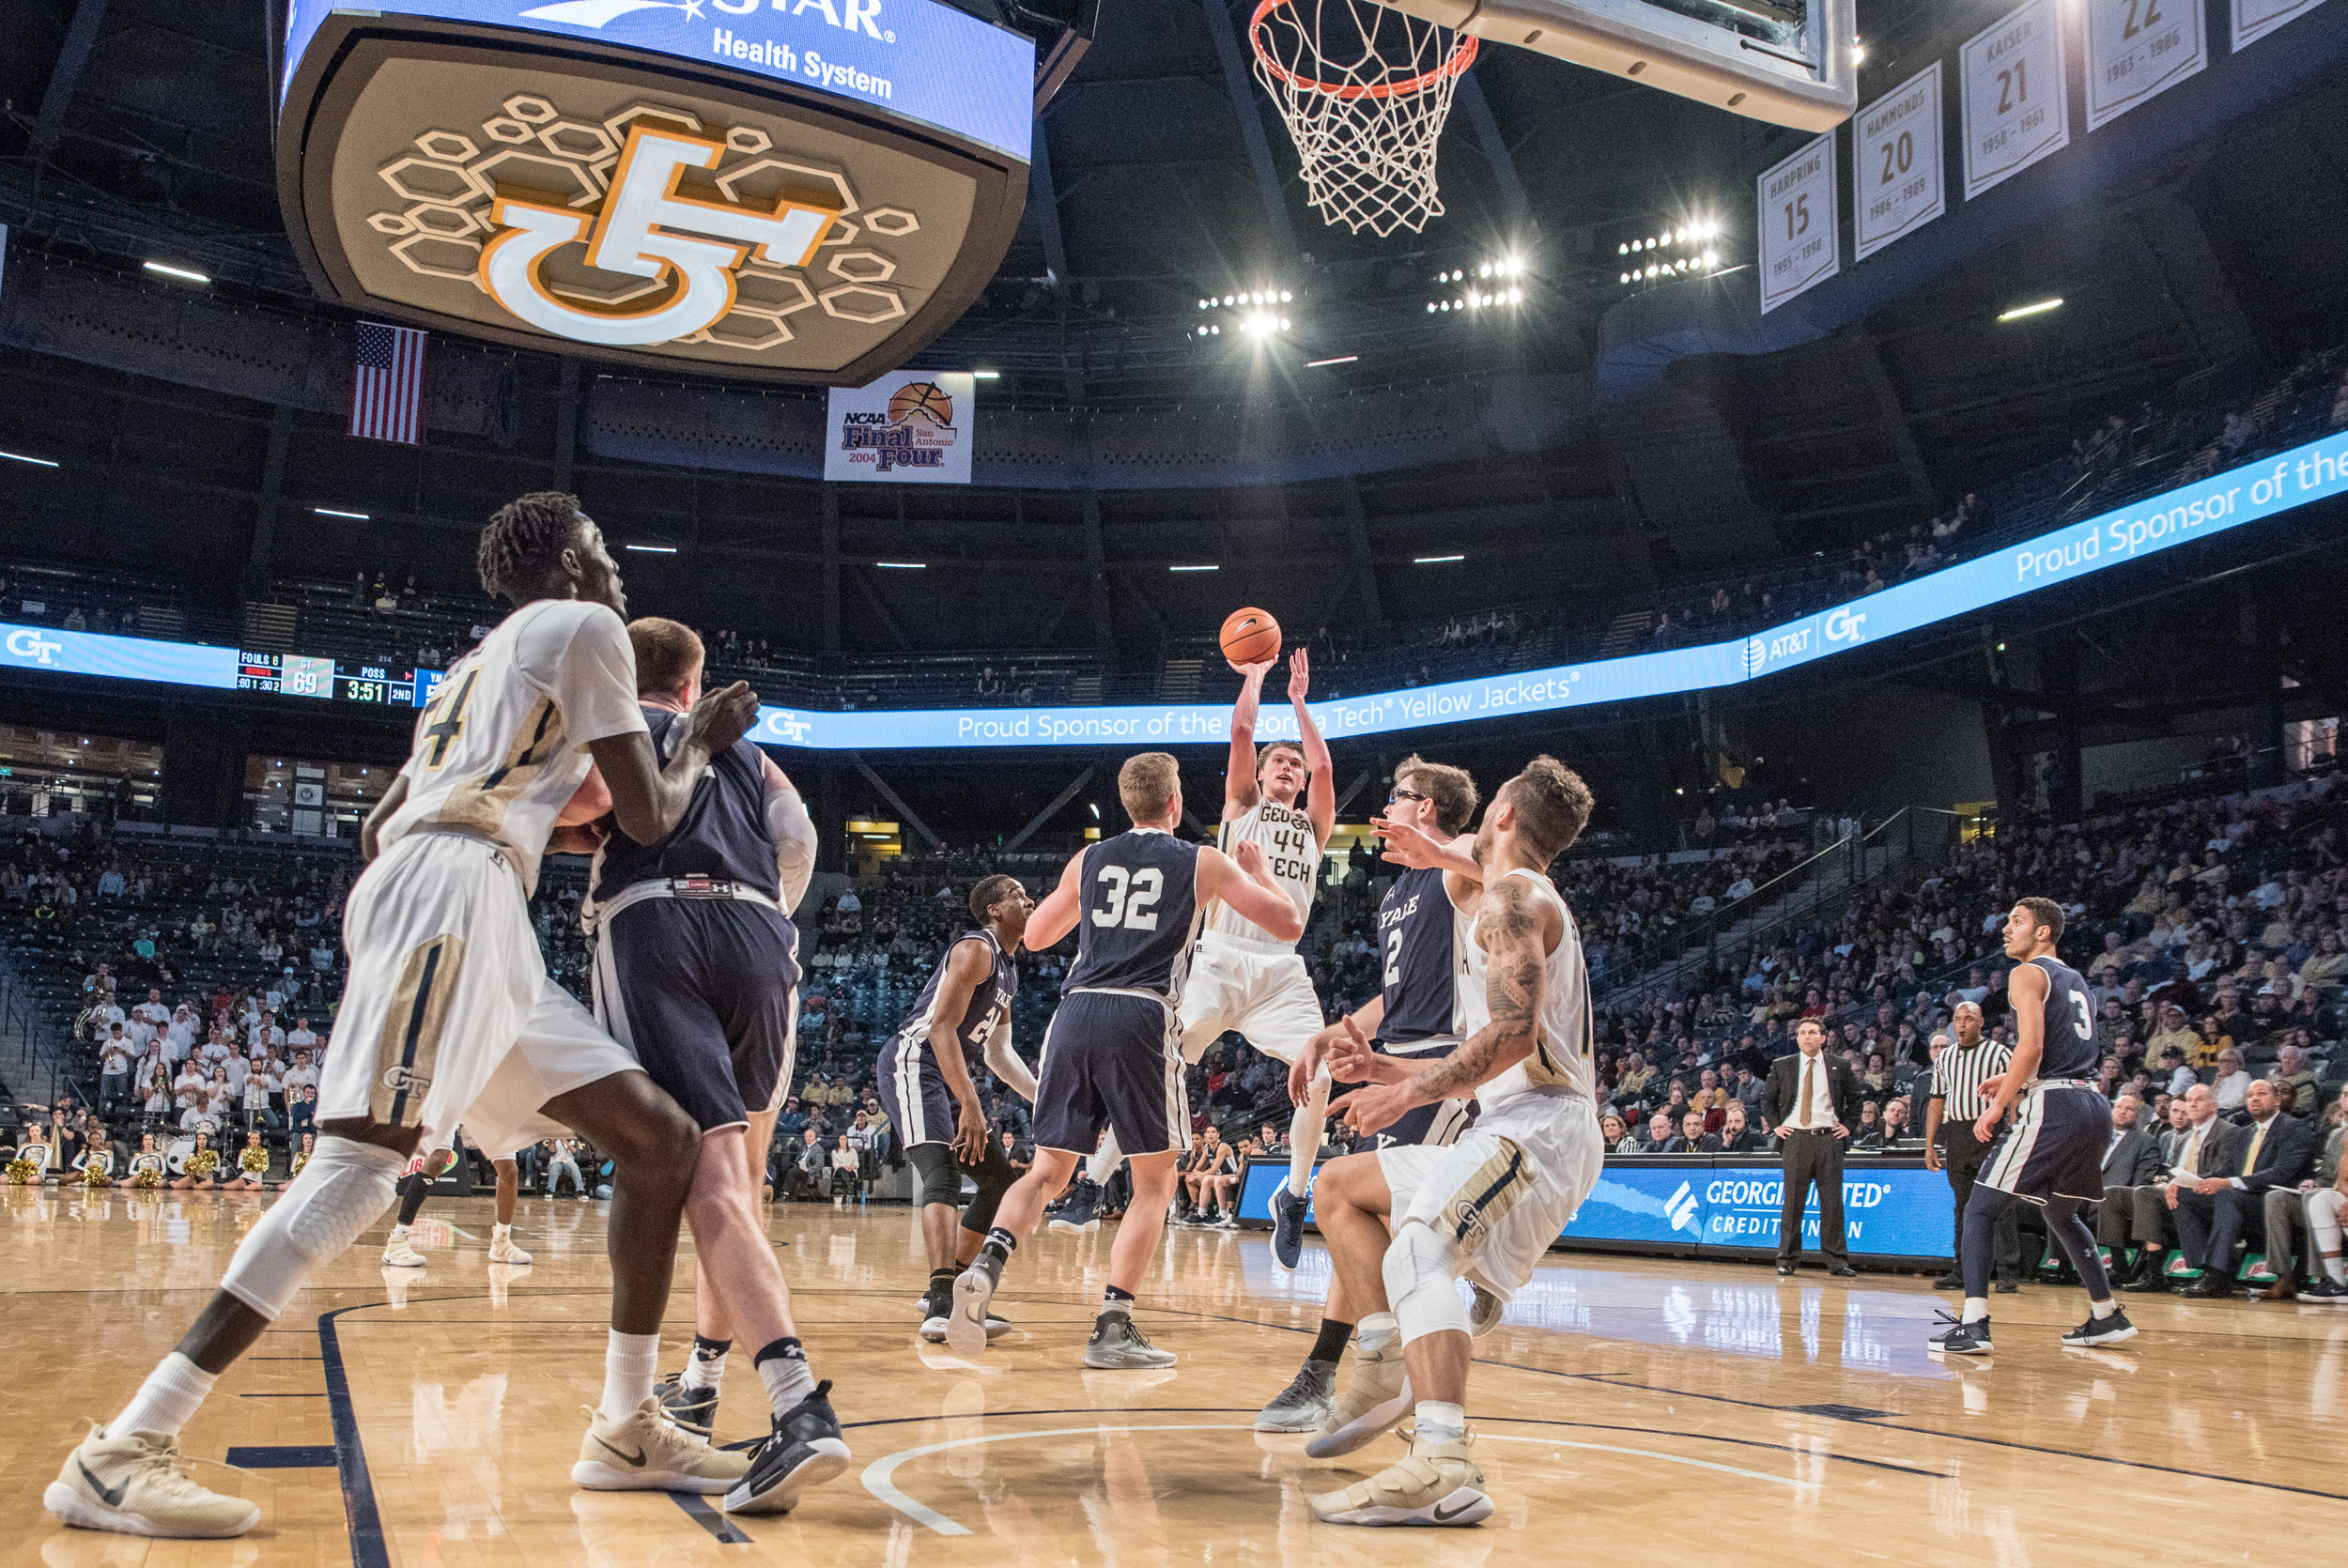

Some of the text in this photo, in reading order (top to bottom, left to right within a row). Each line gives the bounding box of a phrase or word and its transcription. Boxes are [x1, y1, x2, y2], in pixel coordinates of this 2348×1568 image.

[2123, 0, 2162, 40] 22
[1986, 22, 2032, 63] KAISER
[713, 26, 892, 100] Health System
[1997, 58, 2028, 116] 21
[1866, 88, 1925, 139] HAMMONDS
[1881, 131, 1913, 185] 20
[1769, 154, 1822, 199] HARPRING
[1784, 192, 1810, 240] 15
[844, 412, 886, 424] NCAA
[842, 424, 914, 450] Final
[915, 438, 954, 447] Antonio
[916, 428, 934, 438] San
[849, 453, 876, 463] 2004
[875, 448, 943, 471] Four
[2016, 451, 2348, 582] Proud Sponsor of the
[1769, 627, 1812, 661] AT&T
[241, 652, 279, 667] FOULS 6
[245, 667, 272, 677] BONUS
[300, 659, 314, 670] GT
[362, 666, 386, 679] POSS
[273, 681, 280, 692] 2
[292, 670, 318, 695] 69
[348, 680, 383, 702] 3:51
[392, 688, 411, 701] 2ND
[957, 715, 1030, 738] Proud
[1037, 715, 1140, 742] Sponsor
[1147, 712, 1174, 735] of
[1179, 712, 1223, 735] the
[1398, 692, 1473, 719] Yellow
[1274, 829, 1305, 856] 44
[1268, 855, 1311, 884] ECH
[1091, 864, 1165, 931] 32
[1379, 894, 1420, 930] YALE
[1384, 928, 1403, 988] 2
[2068, 990, 2093, 1041] 3
[1707, 1180, 1784, 1206] GEORGI
[1712, 1216, 1782, 1236] CREDIT
